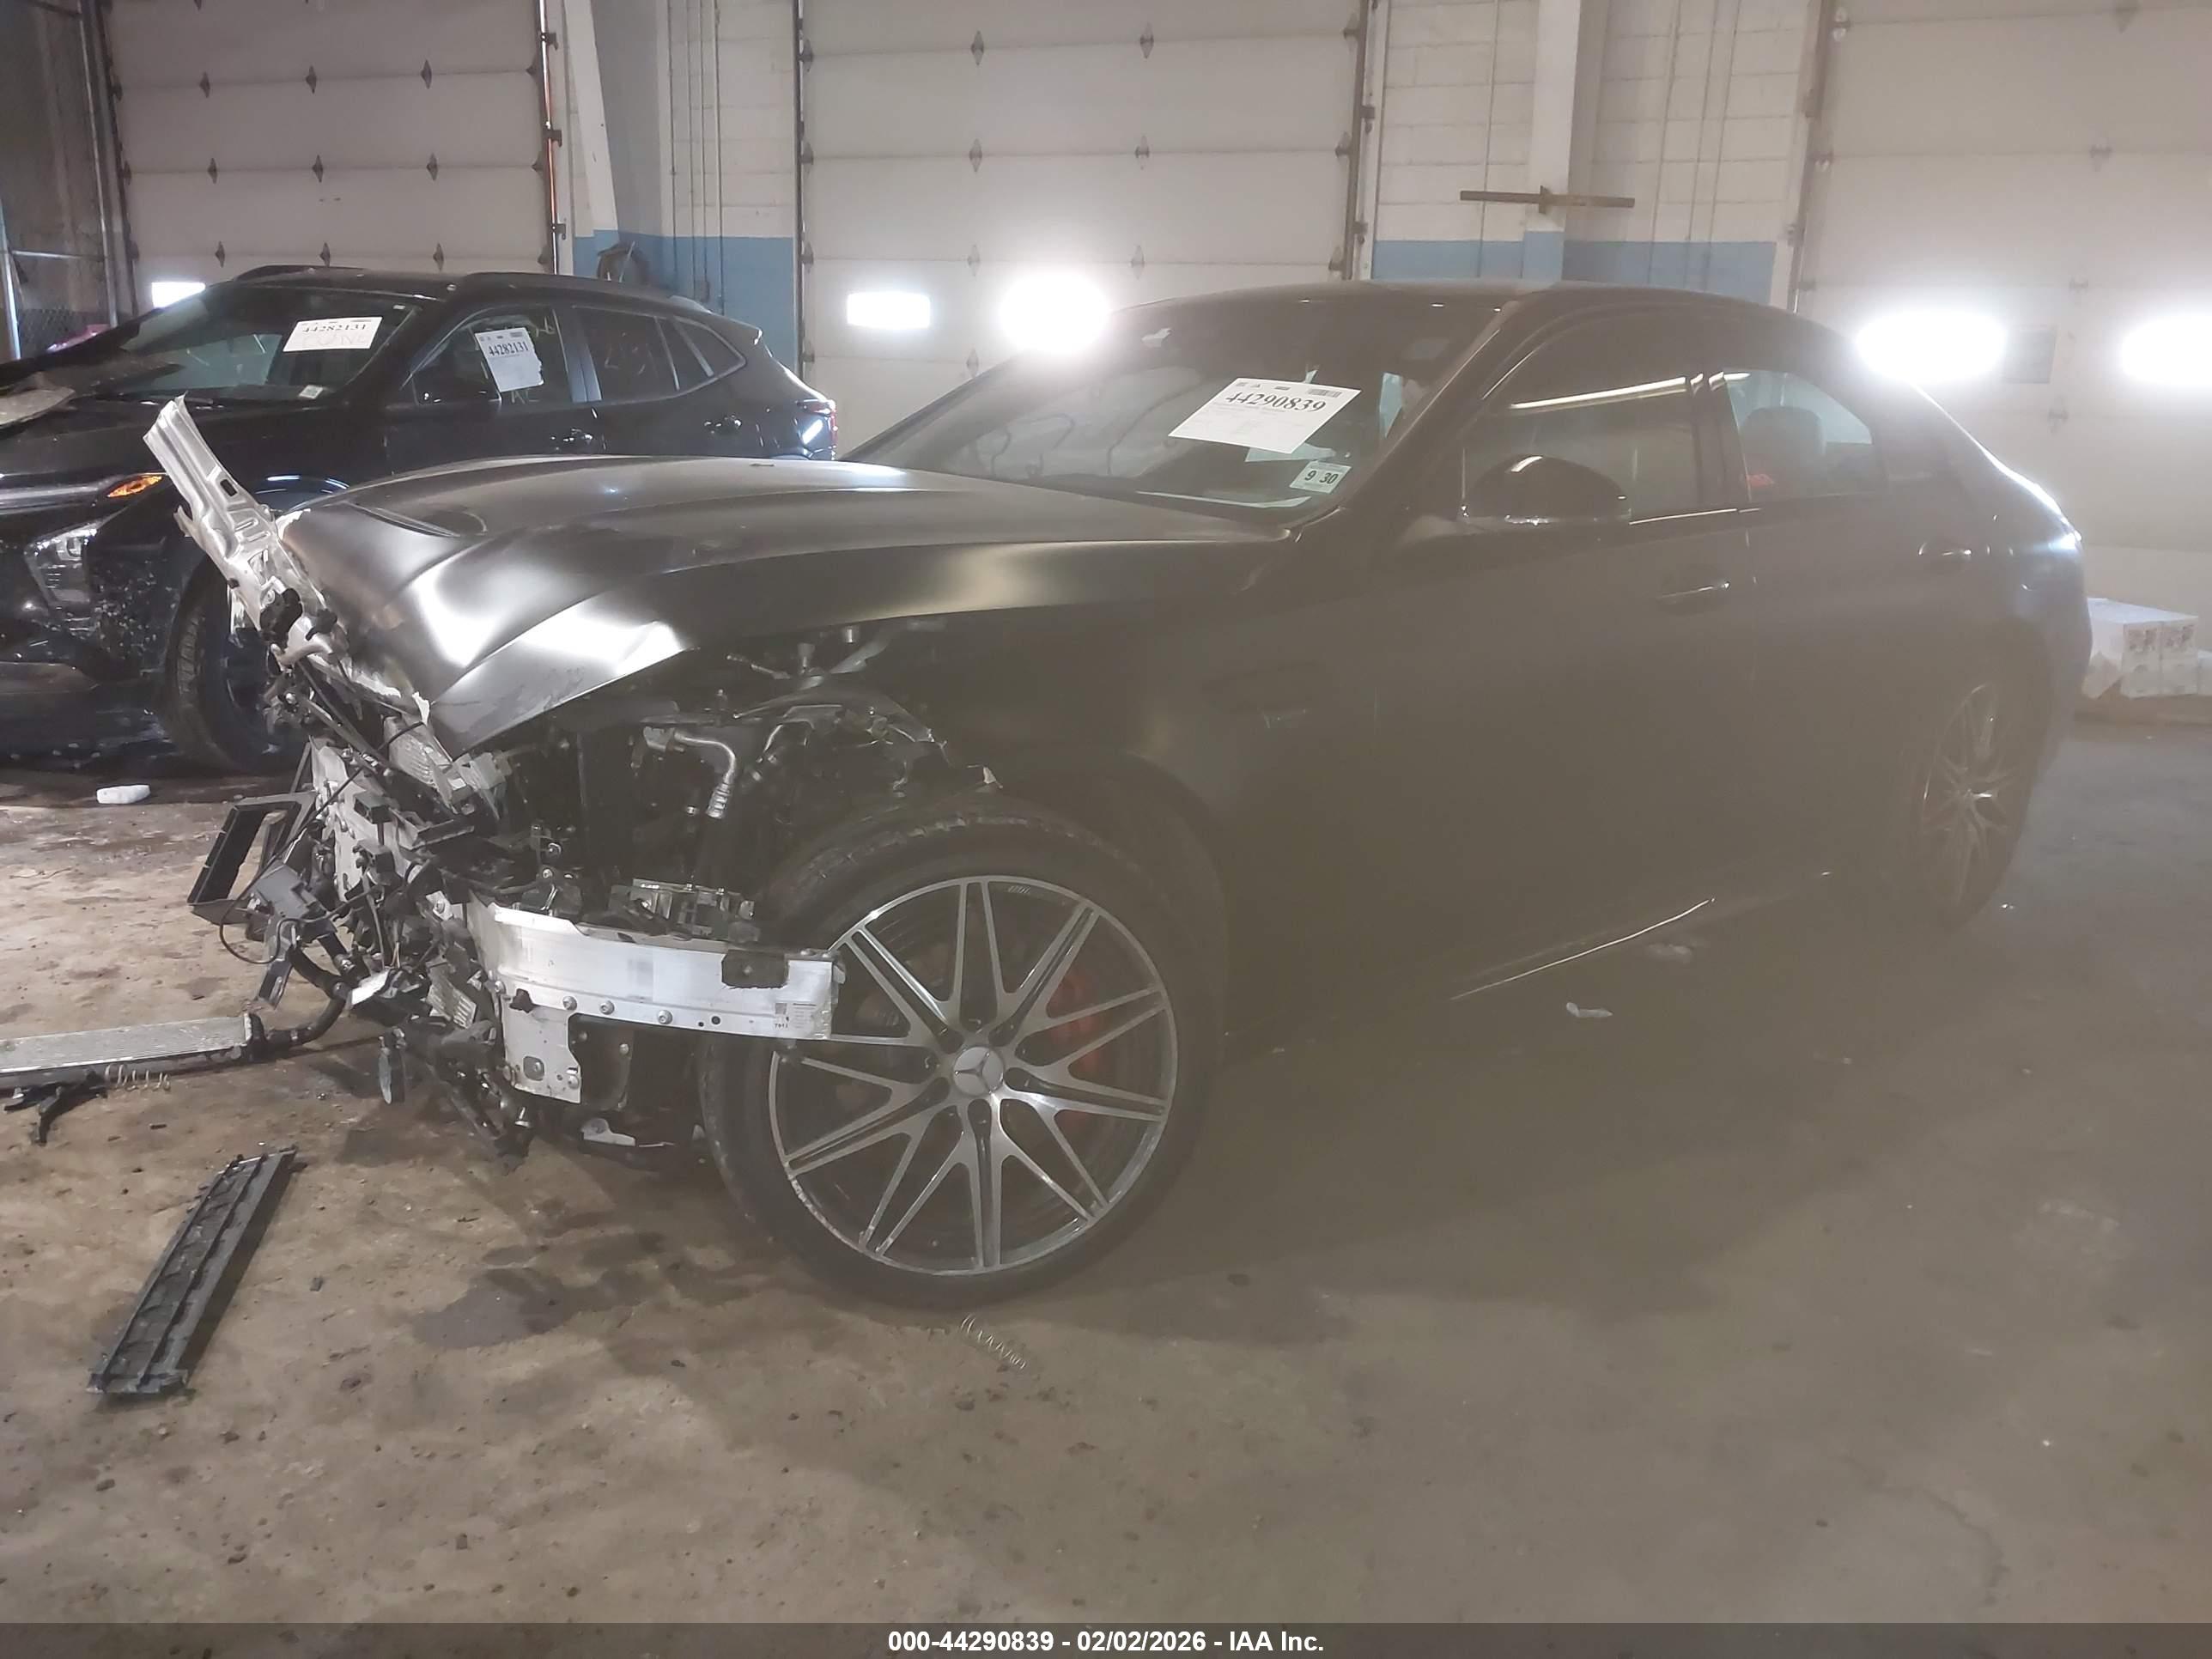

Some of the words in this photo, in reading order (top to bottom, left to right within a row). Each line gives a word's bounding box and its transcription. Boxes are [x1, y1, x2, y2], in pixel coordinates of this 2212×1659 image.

[301, 324, 367, 333] 44282131
[488, 341, 529, 356] 44282131
[1225, 392, 1327, 412] 44290839
[1304, 470, 1317, 481] 9
[1319, 472, 1339, 484] 30
